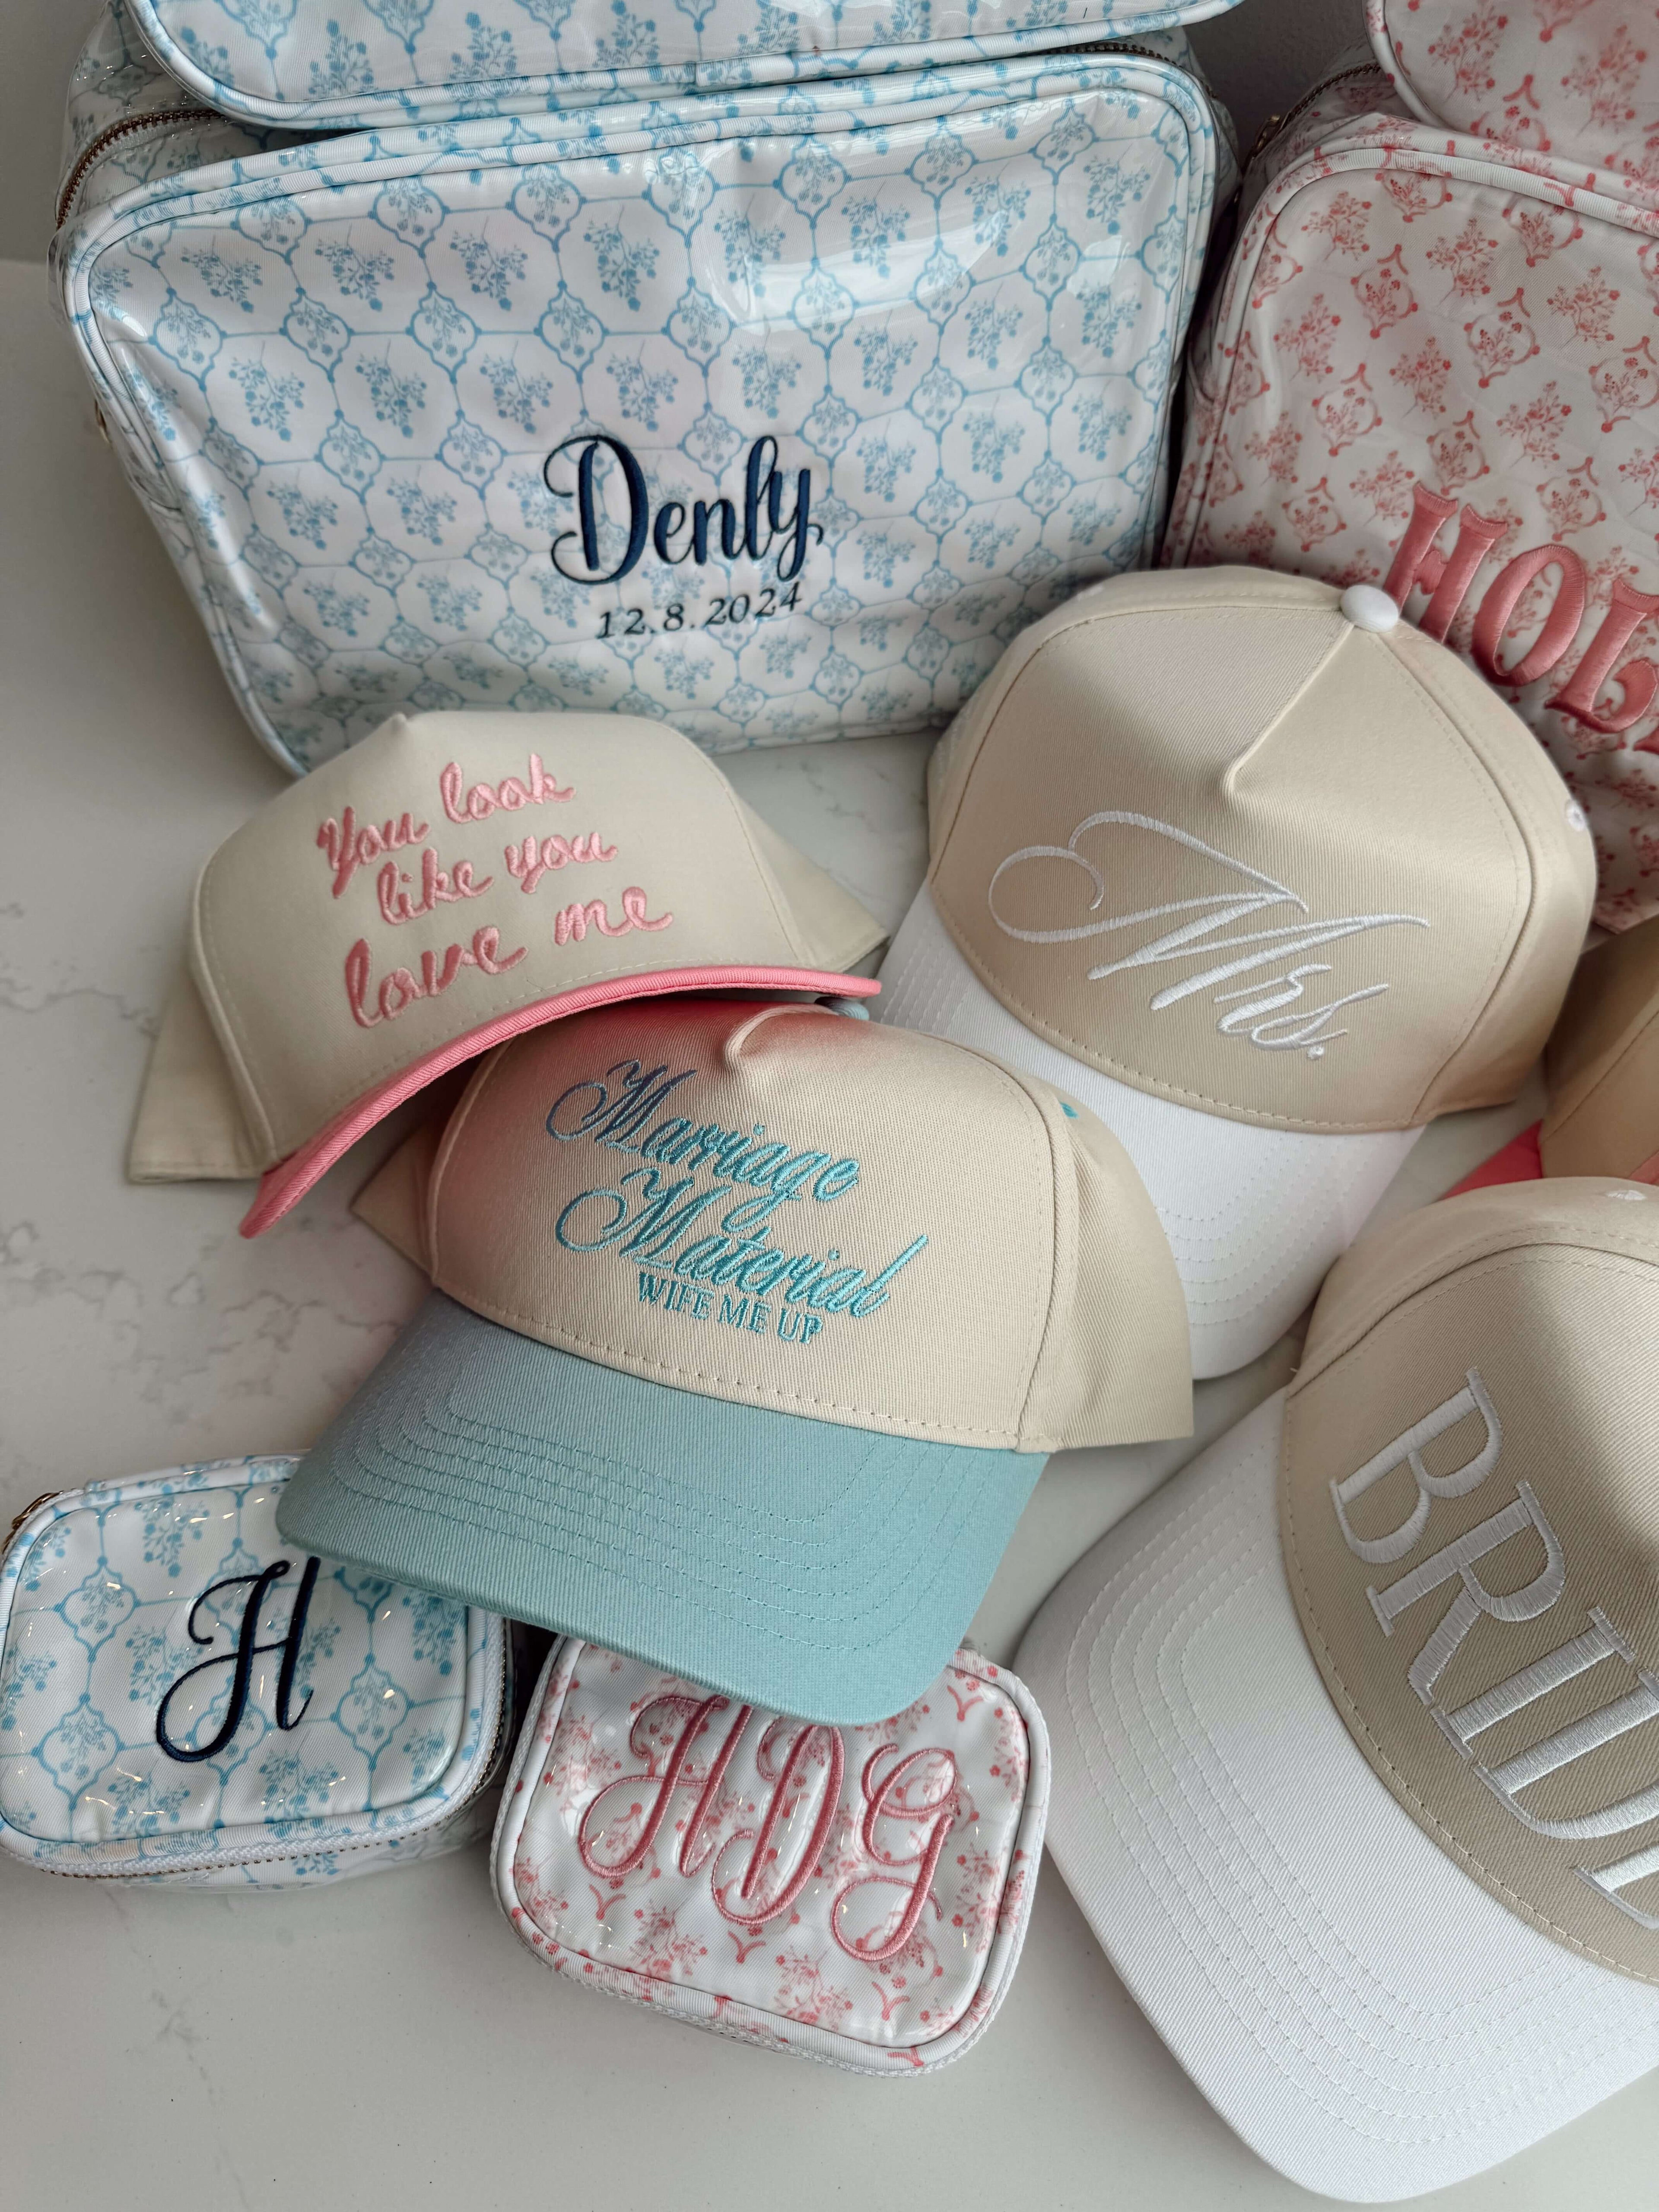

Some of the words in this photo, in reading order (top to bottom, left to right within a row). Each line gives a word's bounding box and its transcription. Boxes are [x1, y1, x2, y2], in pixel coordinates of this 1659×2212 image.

[543, 434, 824, 582] Denly
[596, 582, 803, 639] 12.8.2024
[1382, 480, 1659, 755] HOL
[316, 806, 430, 899] You
[440, 753, 576, 823] look
[377, 848, 495, 926] like
[505, 832, 619, 894] you
[345, 925, 528, 1028] love
[554, 886, 674, 946] me
[988, 810, 1431, 1060] Mrs.
[546, 1058, 861, 1234] Marriage
[554, 1166, 929, 1319] Material
[637, 1271, 715, 1321] WIFE
[718, 1293, 772, 1334] ME
[778, 1308, 823, 1344] UP
